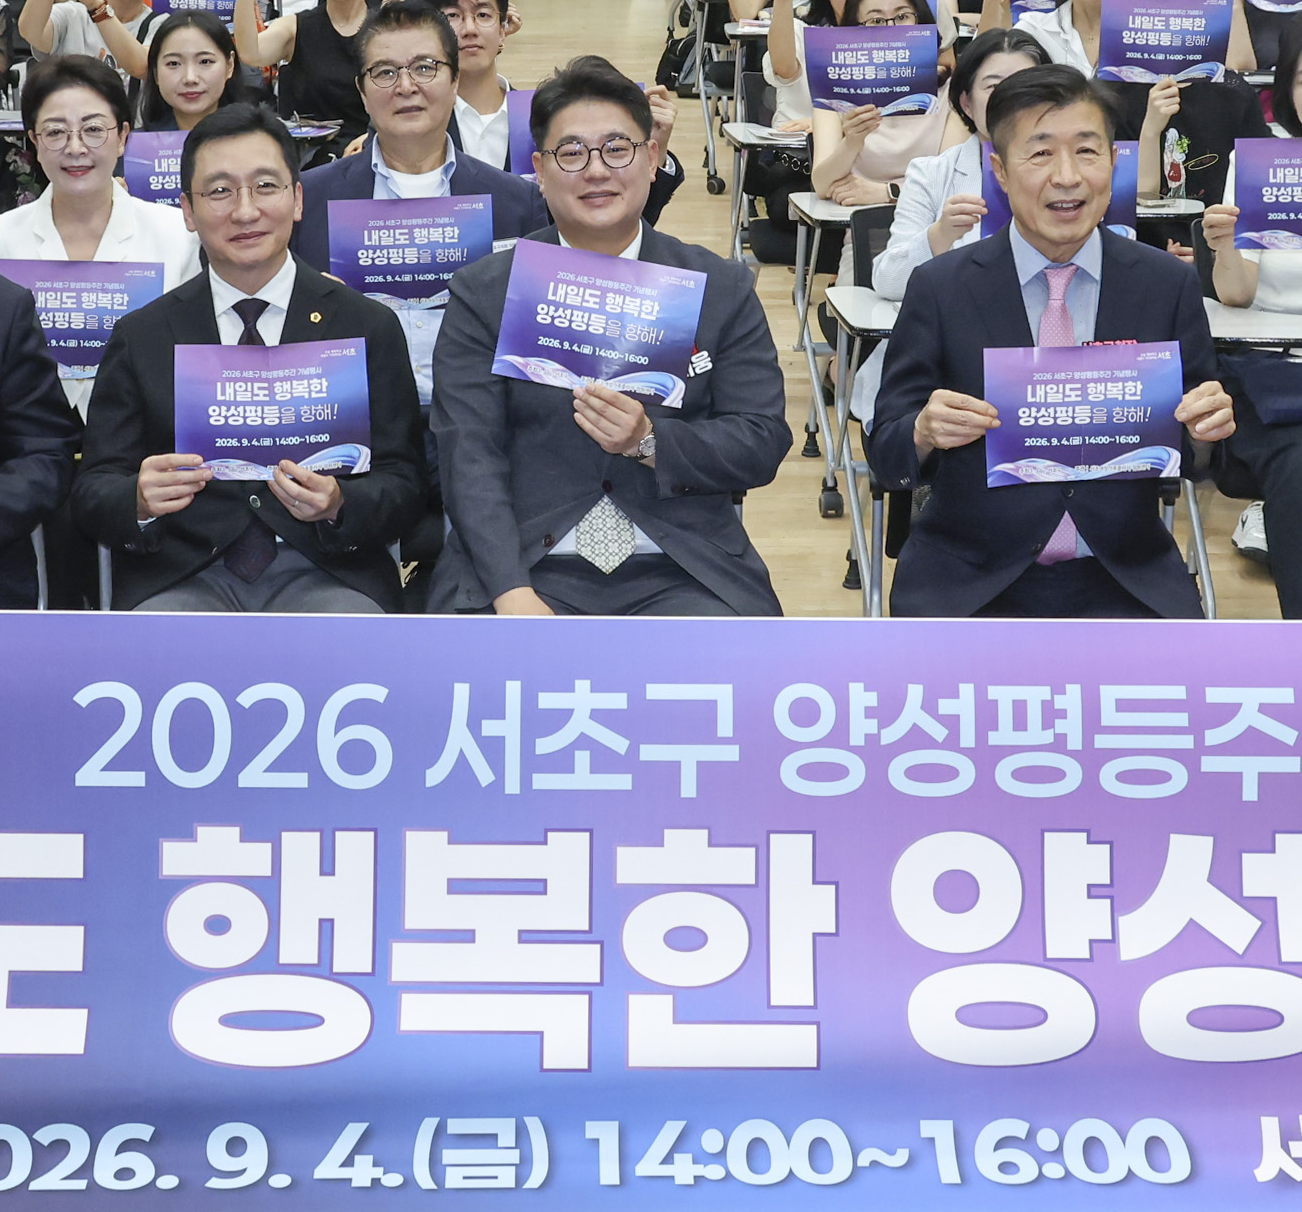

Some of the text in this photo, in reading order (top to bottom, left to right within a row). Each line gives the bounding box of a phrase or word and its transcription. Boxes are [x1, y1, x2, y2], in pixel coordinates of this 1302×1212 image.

[832, 49, 910, 64] 내일도 행복한
[827, 66, 916, 80] 양성평등을 향해!
[547, 282, 660, 321] 내일도 행복한
[536, 303, 664, 345] 양성평등을 향해!
[687, 350, 713, 378] 웅
[216, 378, 328, 401] 내일도 행복한
[1026, 381, 1143, 403] 내일도 행복한
[208, 404, 338, 426] 양성평등을 향해!
[1018, 405, 1151, 426] 양성평등을 향해!
[72, 680, 394, 790] 2026
[424, 678, 734, 798] 서초구
[159, 821, 839, 1072] 행복한
[205, 1122, 291, 1191] 9.
[312, 1114, 550, 1190] 4.(금)
[584, 1118, 1192, 1188] 14:00~16:00
